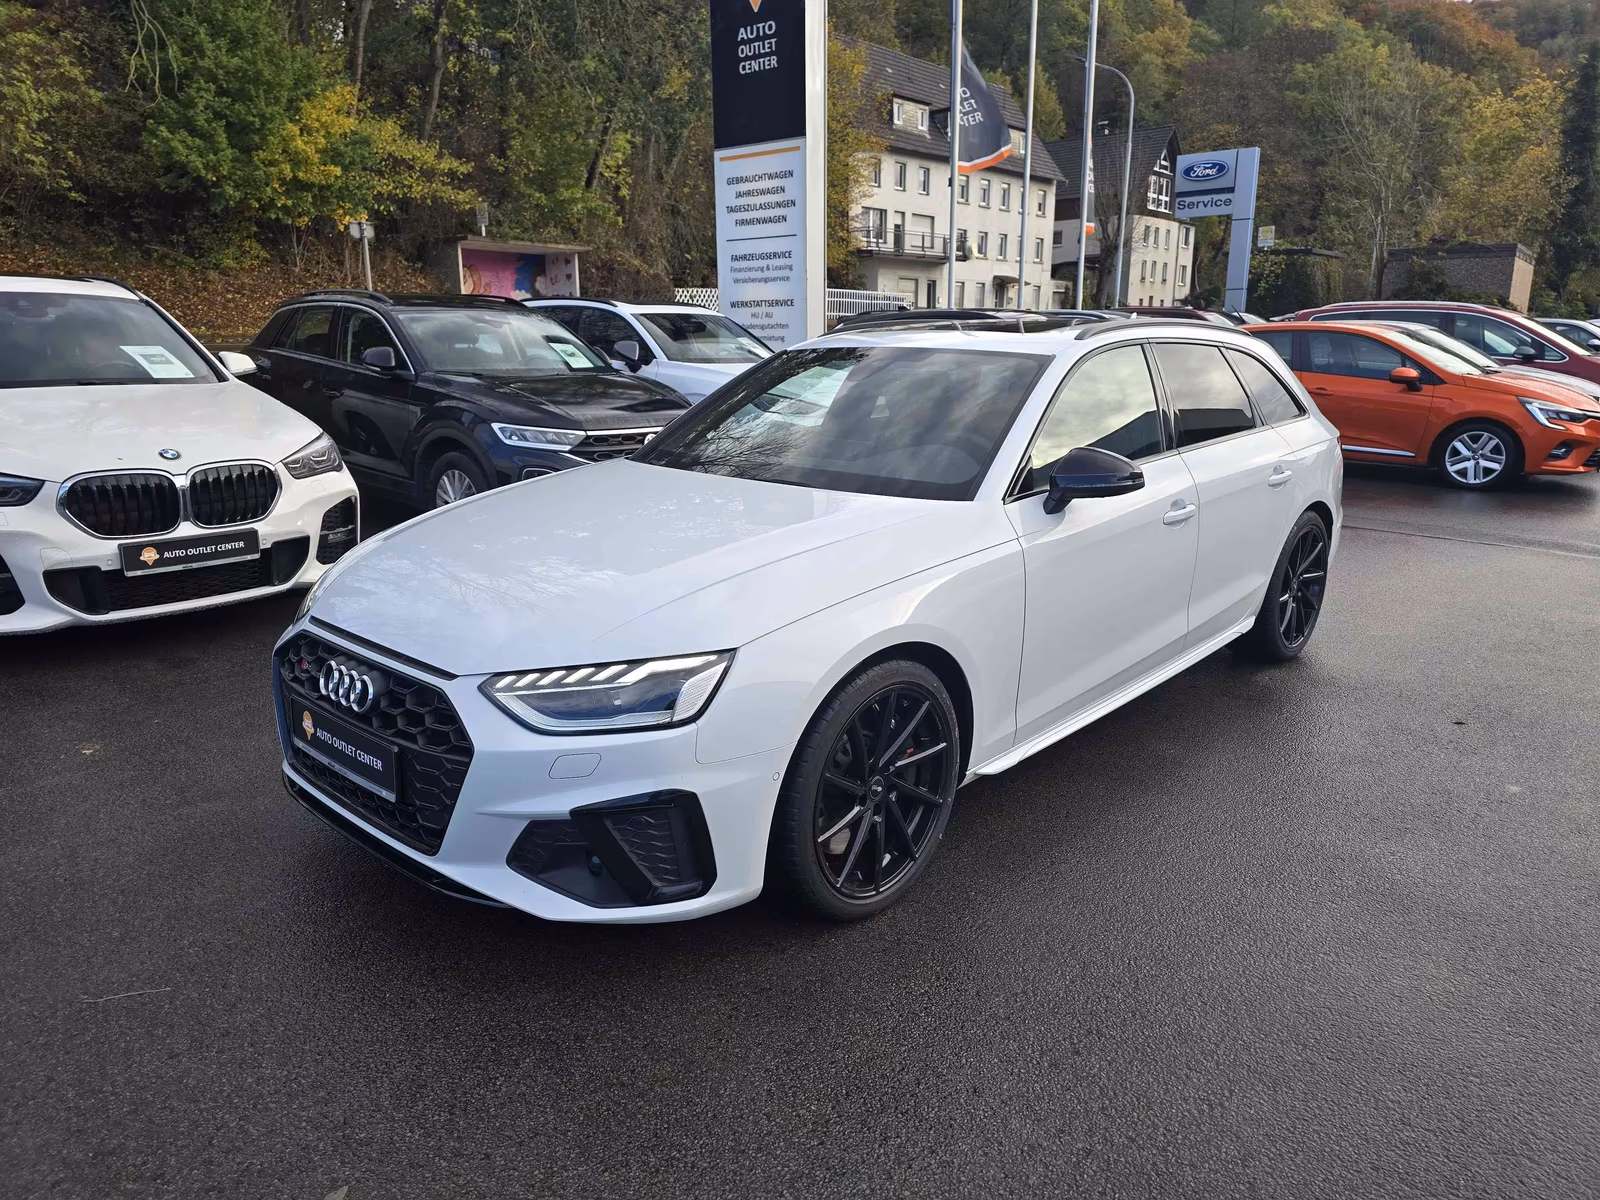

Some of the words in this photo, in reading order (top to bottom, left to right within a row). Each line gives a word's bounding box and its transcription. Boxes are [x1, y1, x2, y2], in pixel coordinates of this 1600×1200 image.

[737, 20, 776, 41] AUTO
[738, 38, 777, 58] OUTLET
[739, 55, 778, 74] CENTER
[1190, 163, 1219, 177] Ford
[726, 169, 794, 186] GEBRAUCHTWAGEN
[735, 185, 785, 199] JAHRESWAGEN
[726, 199, 796, 214] TAGESZULASSUNGEN
[1177, 197, 1232, 210] Service
[735, 214, 787, 227] FIRMENWAGEN
[731, 250, 792, 262] FAHRZEUGSERVICE
[730, 265, 764, 273] Finanzierung
[771, 263, 793, 272] Leasing
[733, 275, 790, 284] Versicherungsservice
[730, 299, 794, 309] WERKSTATTSERVICE
[742, 322, 789, 331] hadensgutachten
[163, 546, 186, 559] AUTO
[187, 543, 216, 556] OUTLET
[217, 541, 245, 551] CENTER
[316, 727, 332, 744] AUTO
[332, 735, 356, 758] OUTLET
[356, 748, 383, 771] CENTER
